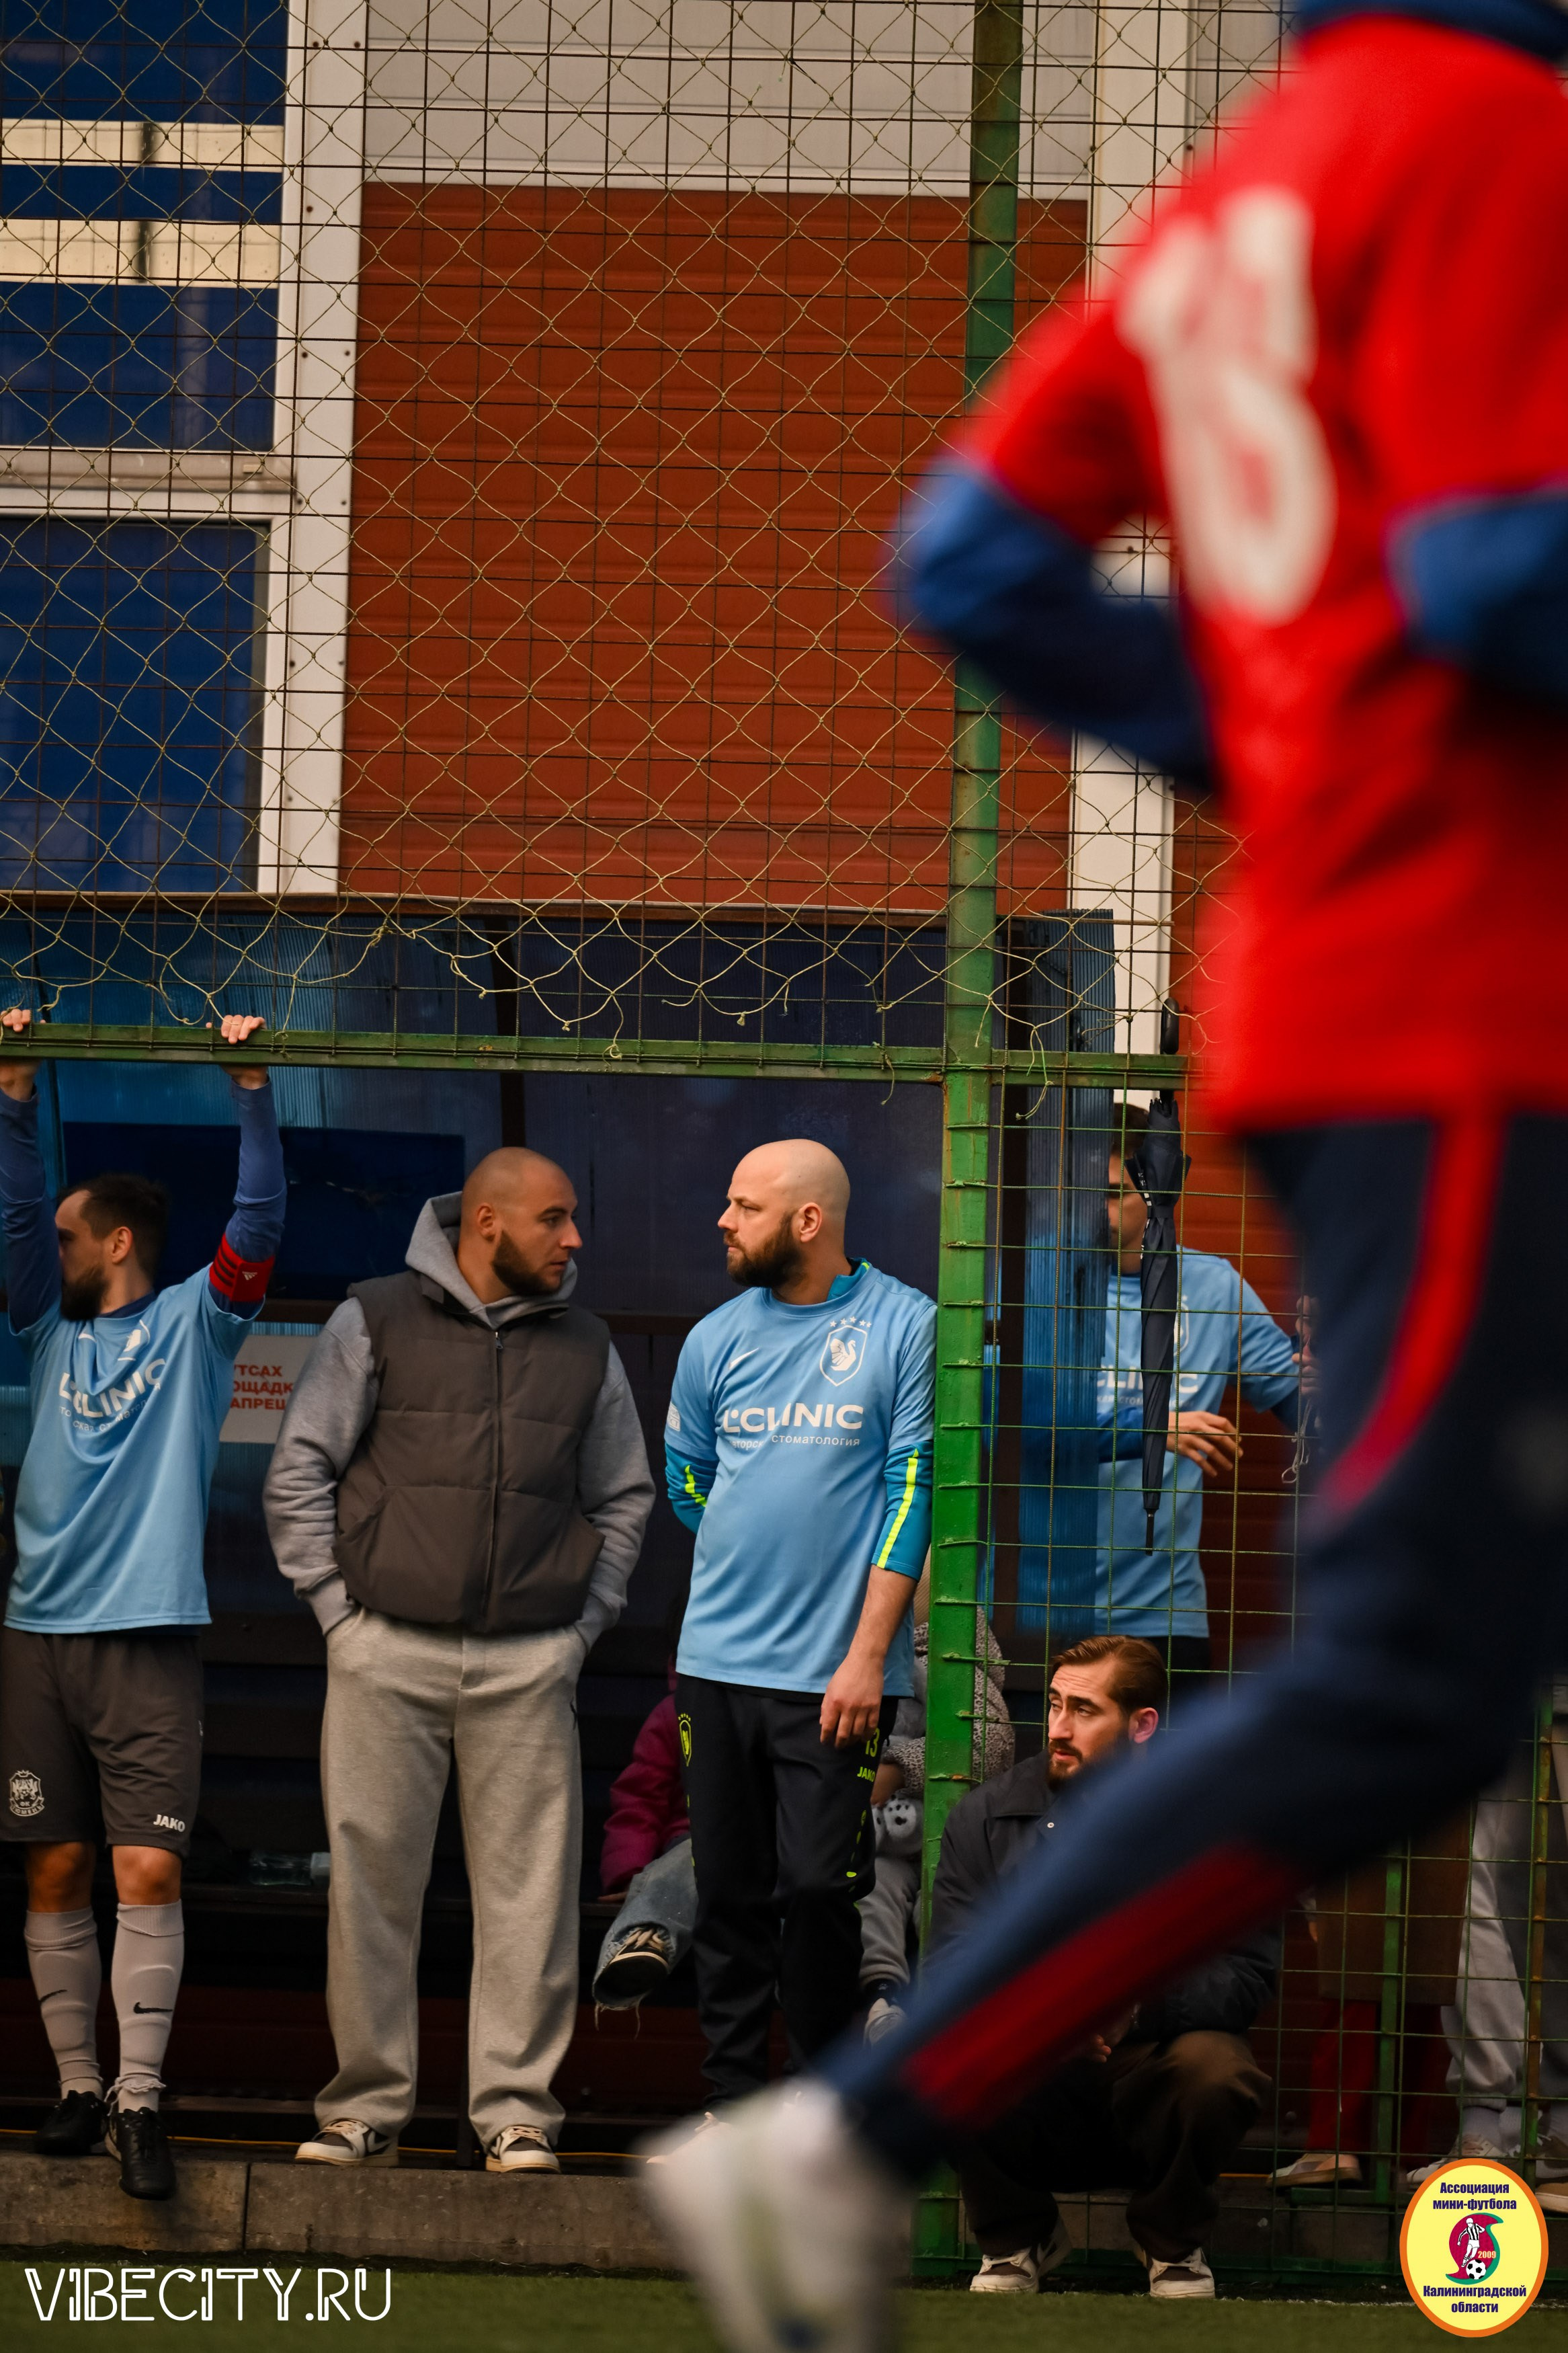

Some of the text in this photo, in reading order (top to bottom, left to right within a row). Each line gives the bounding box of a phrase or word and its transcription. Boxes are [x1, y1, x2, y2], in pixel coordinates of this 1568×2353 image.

[234, 1364, 282, 1377] ТСАХ
[233, 1381, 293, 1396] ОЩАДК
[230, 1397, 286, 1410] АПРЕ
[772, 1435, 860, 1446] стоматология
[153, 1814, 185, 1832] JAKO
